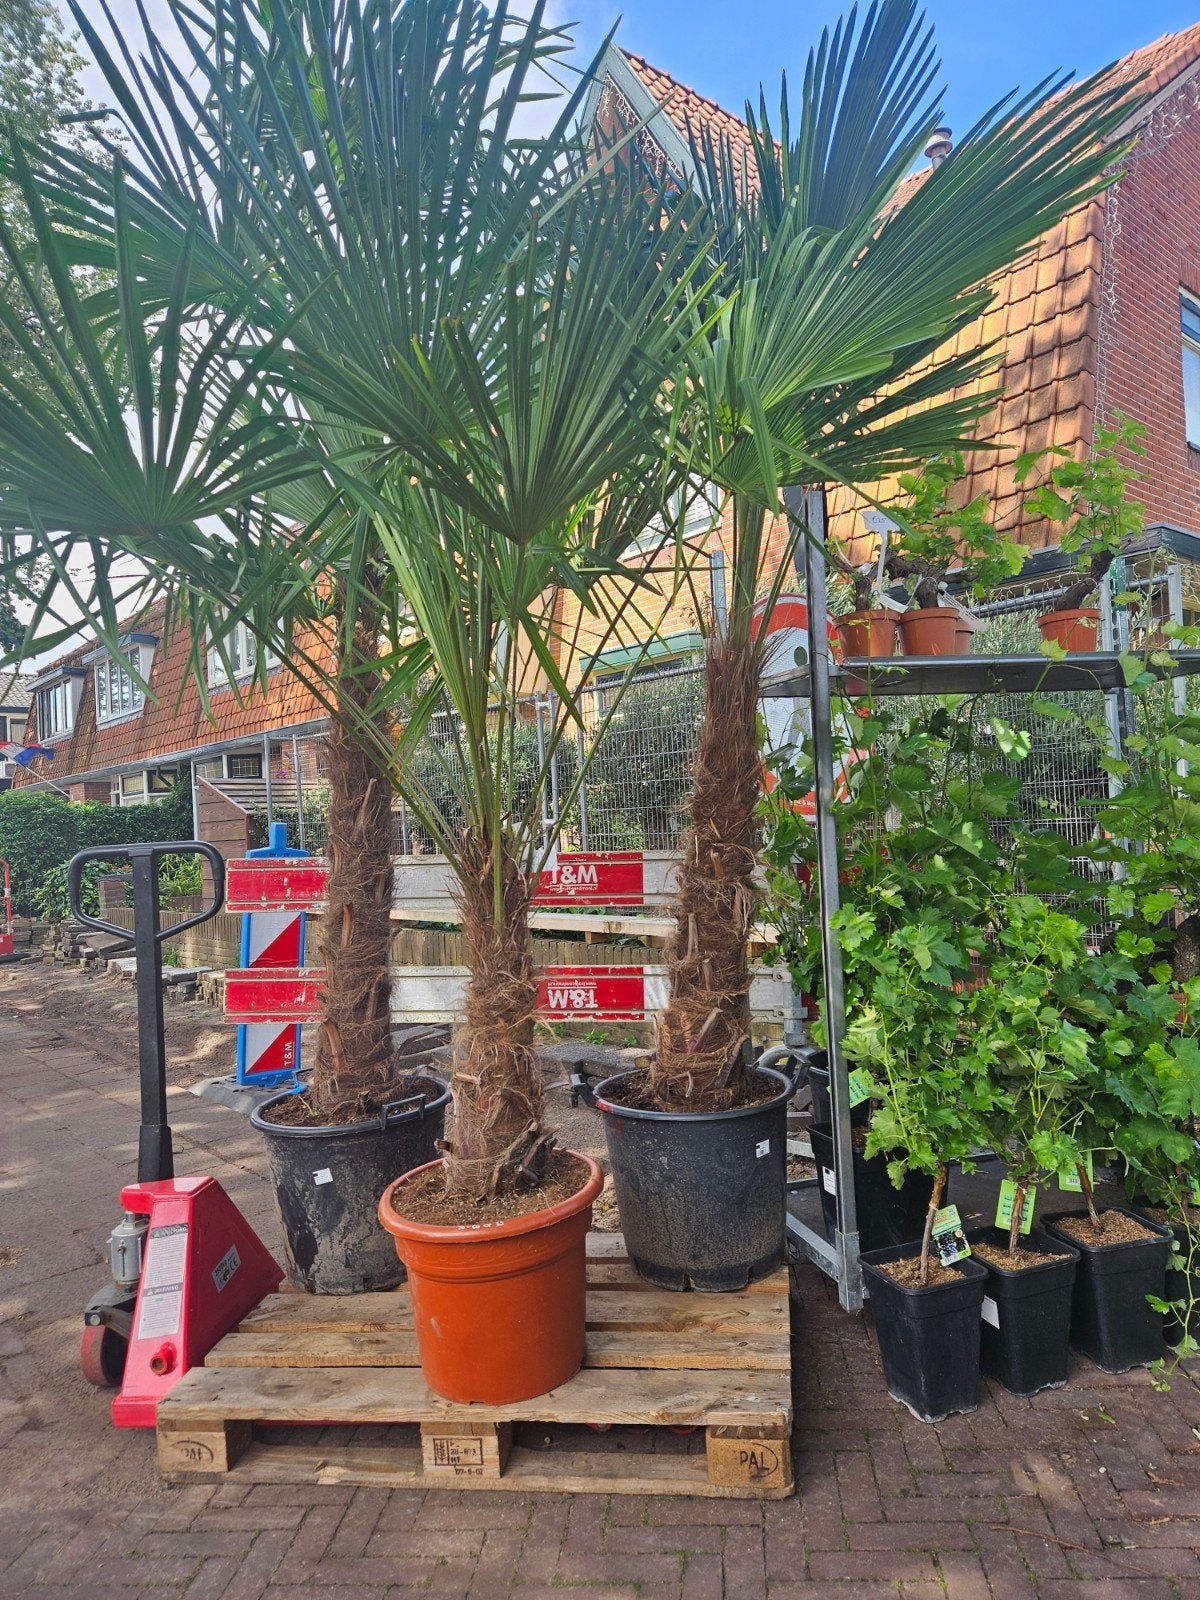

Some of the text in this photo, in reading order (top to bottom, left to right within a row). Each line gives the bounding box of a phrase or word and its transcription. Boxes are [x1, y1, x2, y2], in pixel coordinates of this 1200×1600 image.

[547, 989, 599, 1009] T&M
[284, 1041, 293, 1067] T&M
[739, 1450, 770, 1470] PAL
